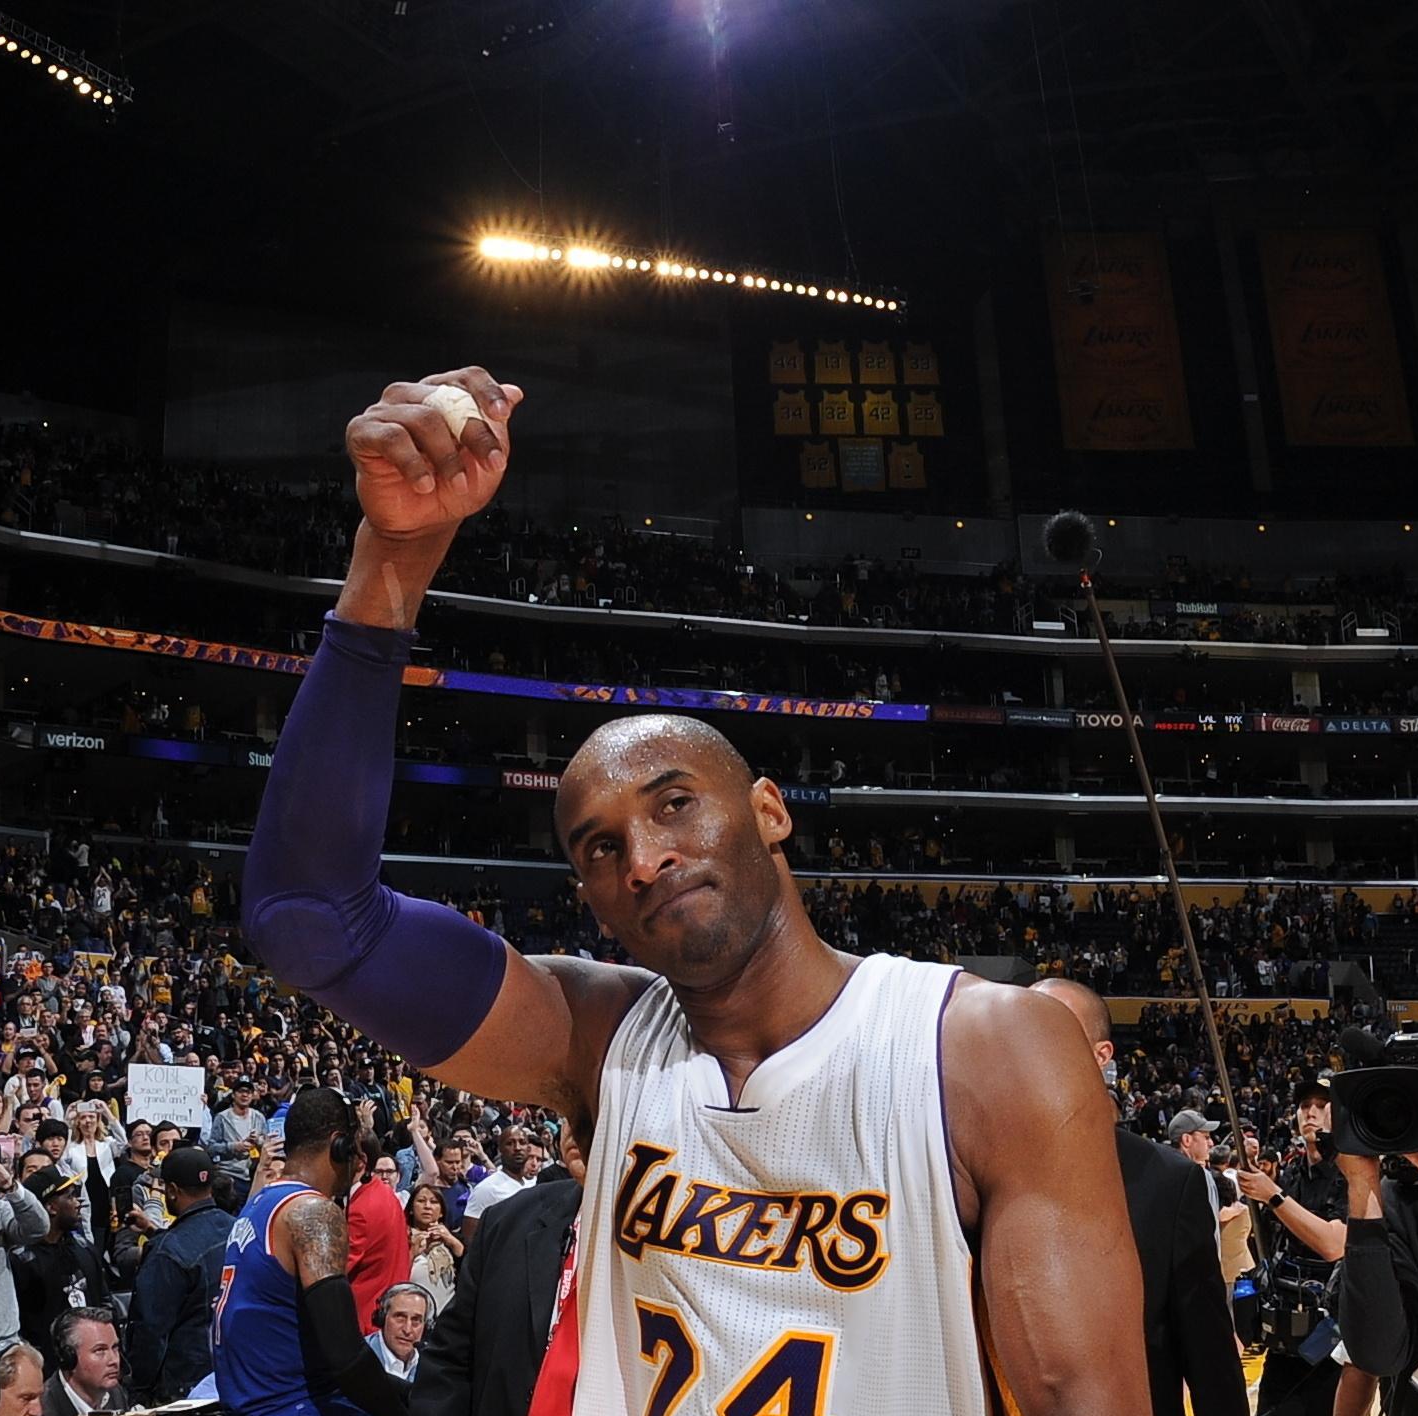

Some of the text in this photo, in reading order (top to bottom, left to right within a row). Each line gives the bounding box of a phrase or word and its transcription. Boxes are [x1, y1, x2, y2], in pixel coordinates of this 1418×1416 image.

[825, 406, 848, 420] 32
[868, 406, 891, 420] 42
[1175, 601, 1218, 614] StubHub!
[754, 697, 875, 718] LAKERS
[1076, 713, 1145, 728] TOYOA
[1341, 721, 1390, 732] DELTA
[46, 732, 105, 750] verizon
[503, 771, 559, 789] TOSHIB
[183, 1085, 198, 1096] 20
[615, 1140, 892, 1294] LAKERS
